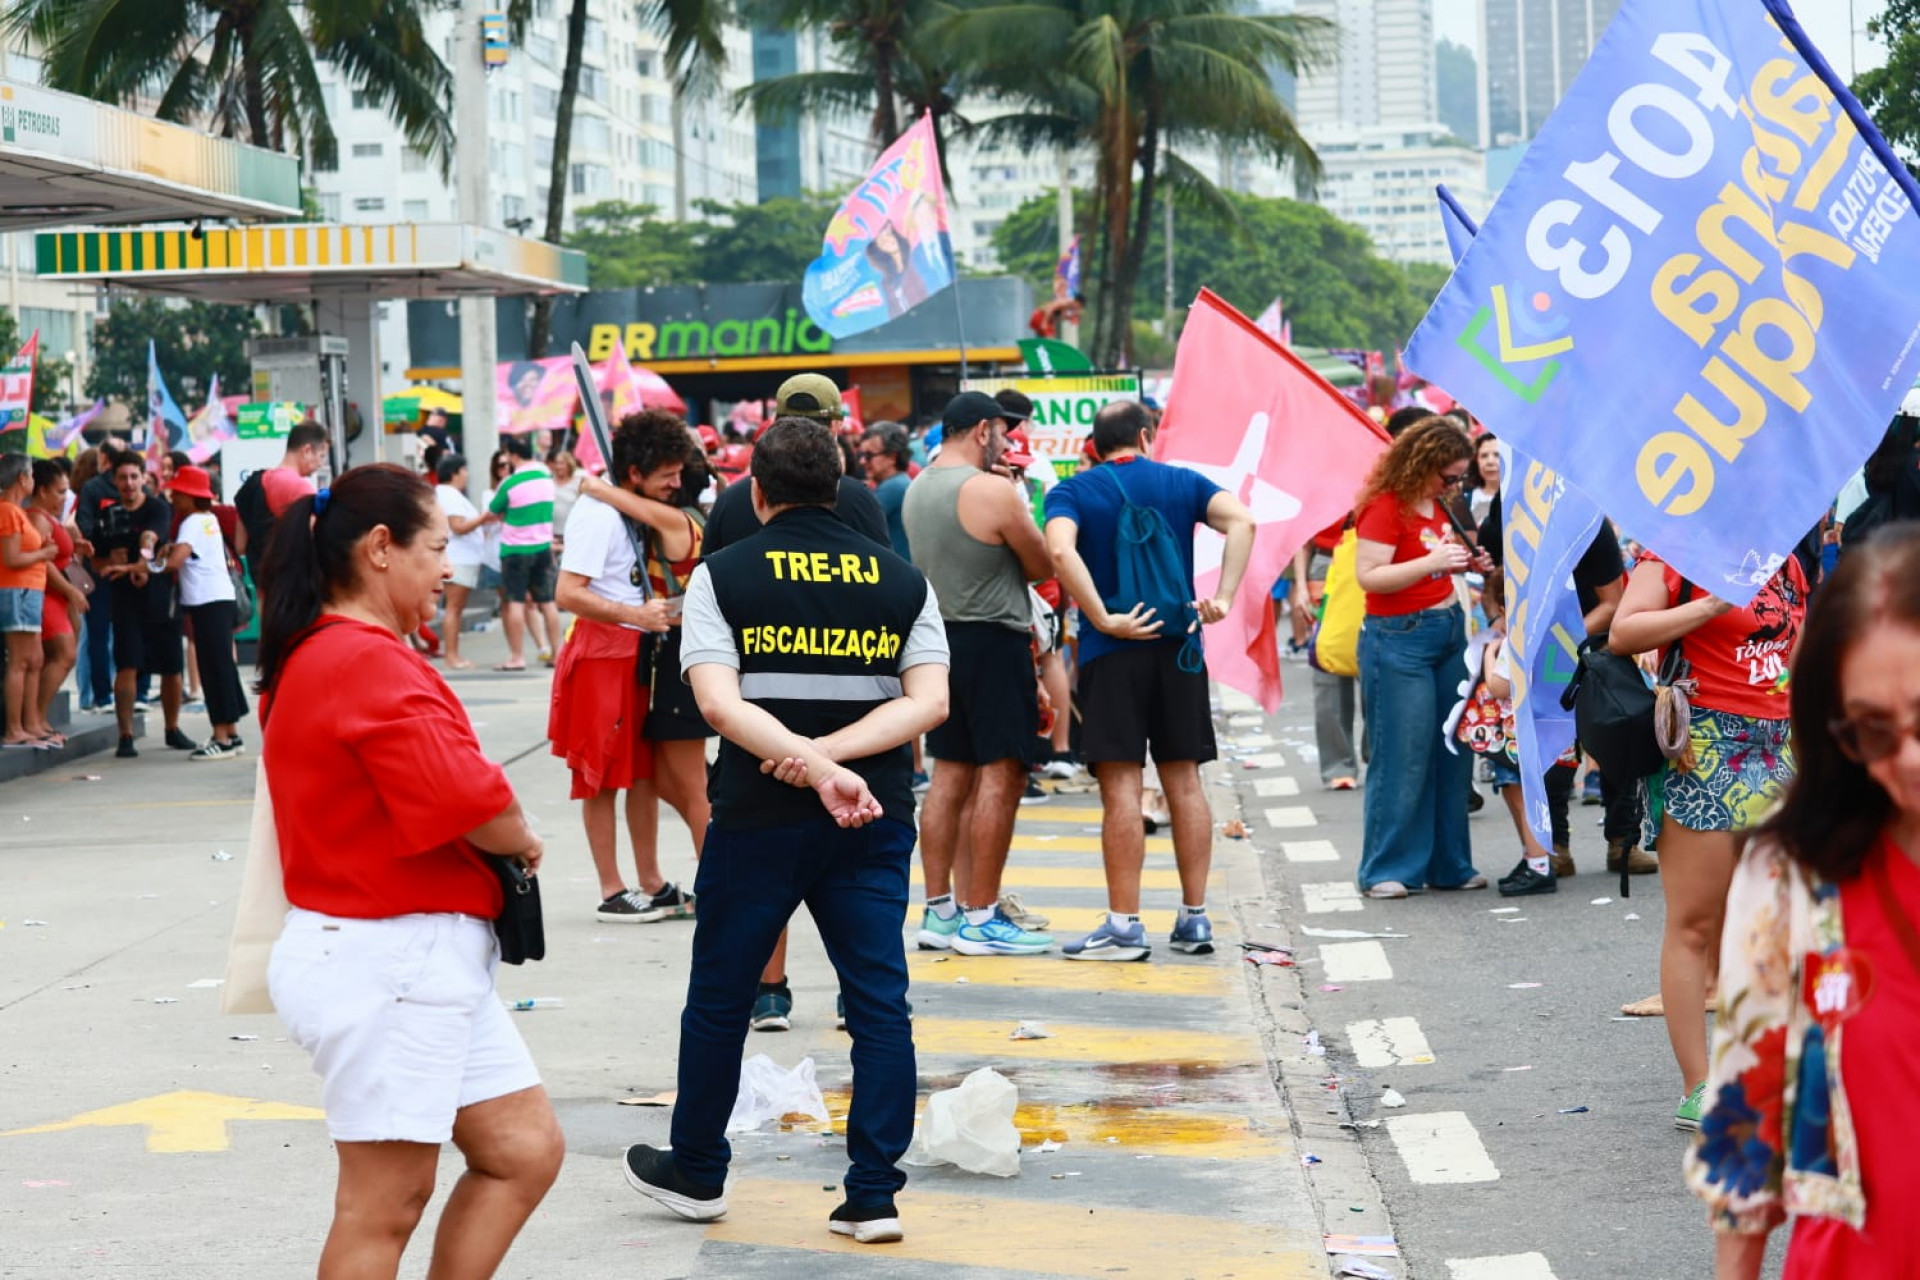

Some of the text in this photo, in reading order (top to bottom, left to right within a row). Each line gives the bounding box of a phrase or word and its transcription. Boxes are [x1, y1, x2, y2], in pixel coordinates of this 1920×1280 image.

[18, 109, 60, 137] PETROBRAS
[765, 551, 880, 584] TRE-RJ
[741, 625, 901, 665] FISCALIZAÇÃO
